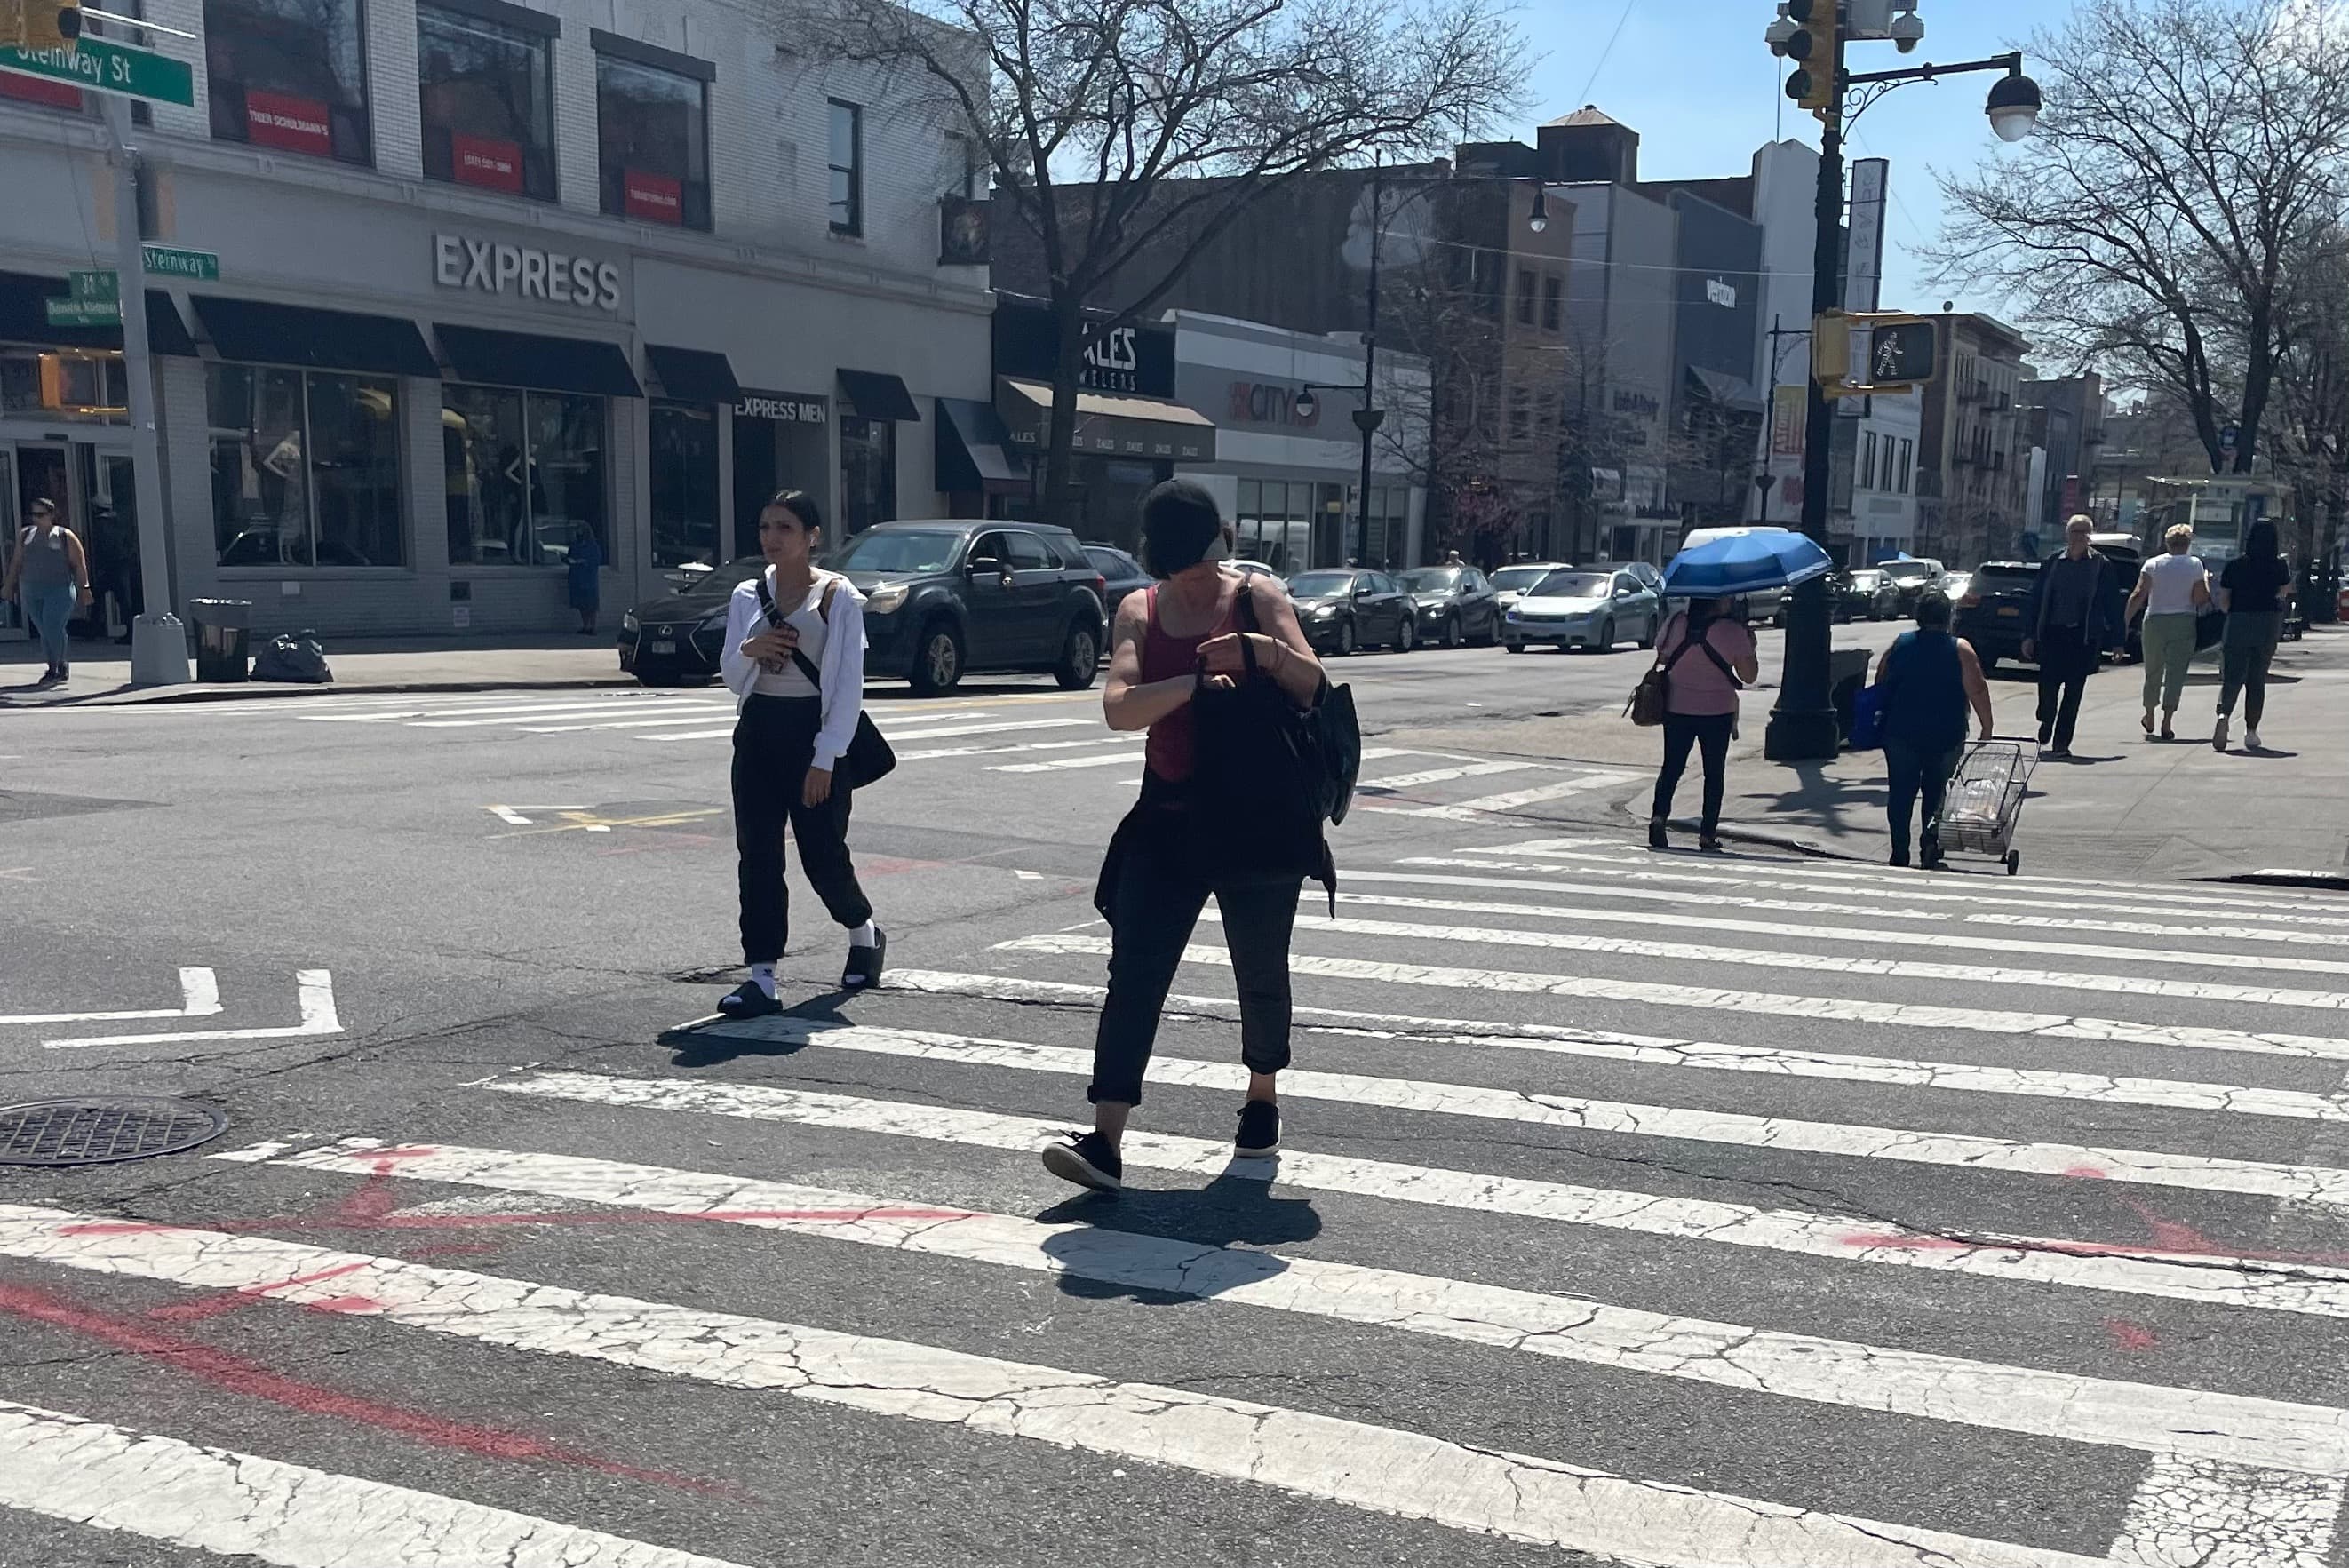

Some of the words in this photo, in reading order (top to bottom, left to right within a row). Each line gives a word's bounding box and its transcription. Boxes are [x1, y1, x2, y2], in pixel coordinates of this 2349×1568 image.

[111, 54, 131, 84] St
[144, 250, 204, 278] Steinway
[433, 233, 621, 312] EXPRESS
[1081, 322, 1136, 370] ALES
[735, 396, 797, 421] EXPRESS
[798, 402, 826, 423] MEN
[1008, 431, 1036, 442] ALES
